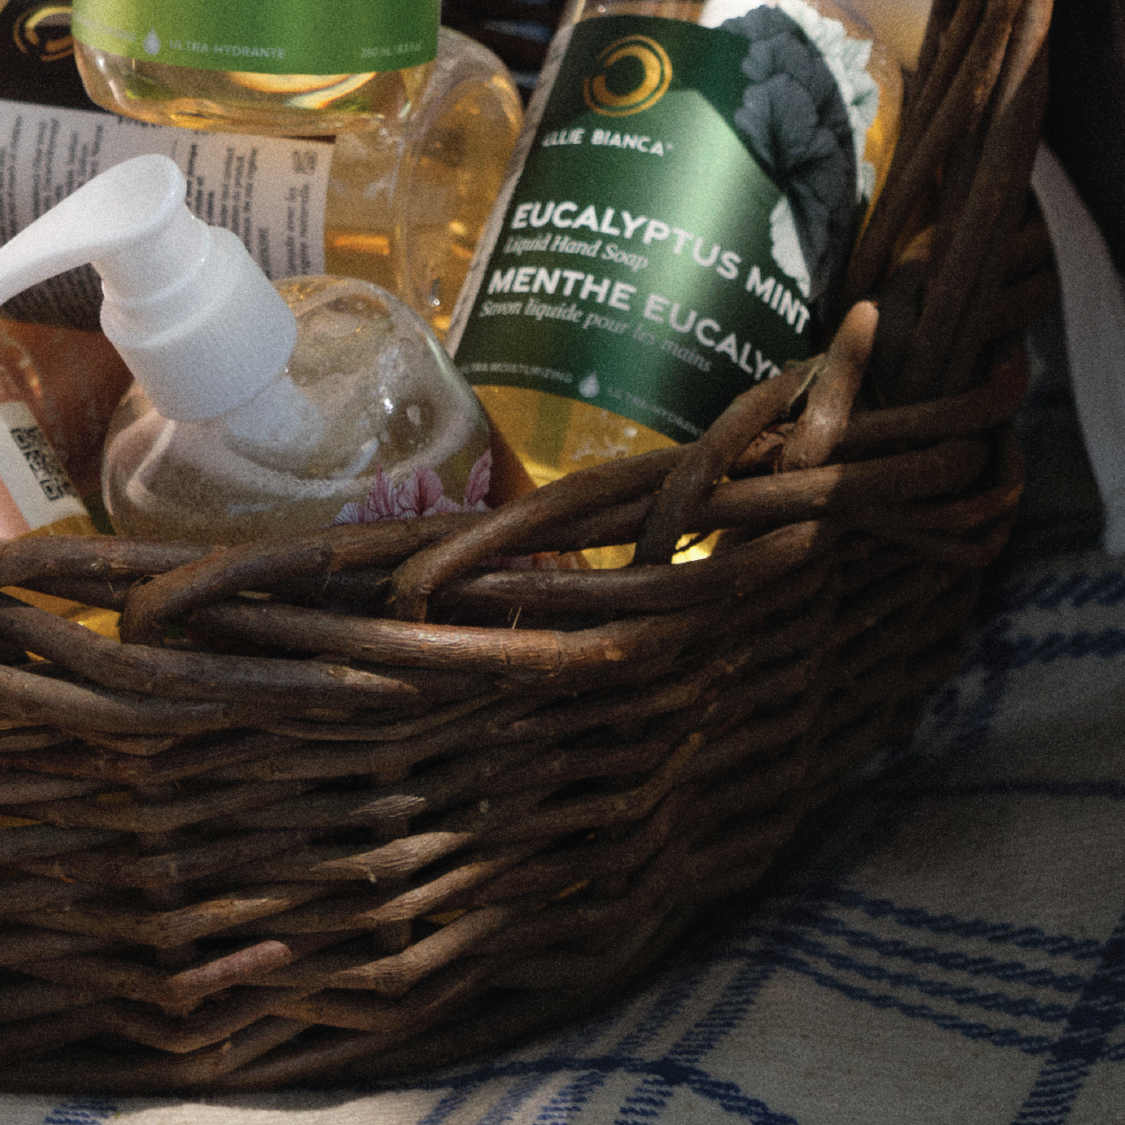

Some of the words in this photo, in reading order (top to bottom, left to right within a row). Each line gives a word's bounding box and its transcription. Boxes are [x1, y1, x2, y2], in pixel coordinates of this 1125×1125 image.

[503, 233, 552, 257] Liquid
[550, 235, 603, 258] Hand
[601, 242, 650, 272] Soap
[511, 200, 742, 280] EUCALYPTUS
[745, 265, 810, 335] MINT
[487, 266, 637, 312] MENTHE
[479, 299, 524, 318] Savon
[524, 296, 584, 323] liquide
[582, 312, 632, 335] pour
[660, 338, 713, 373] mains
